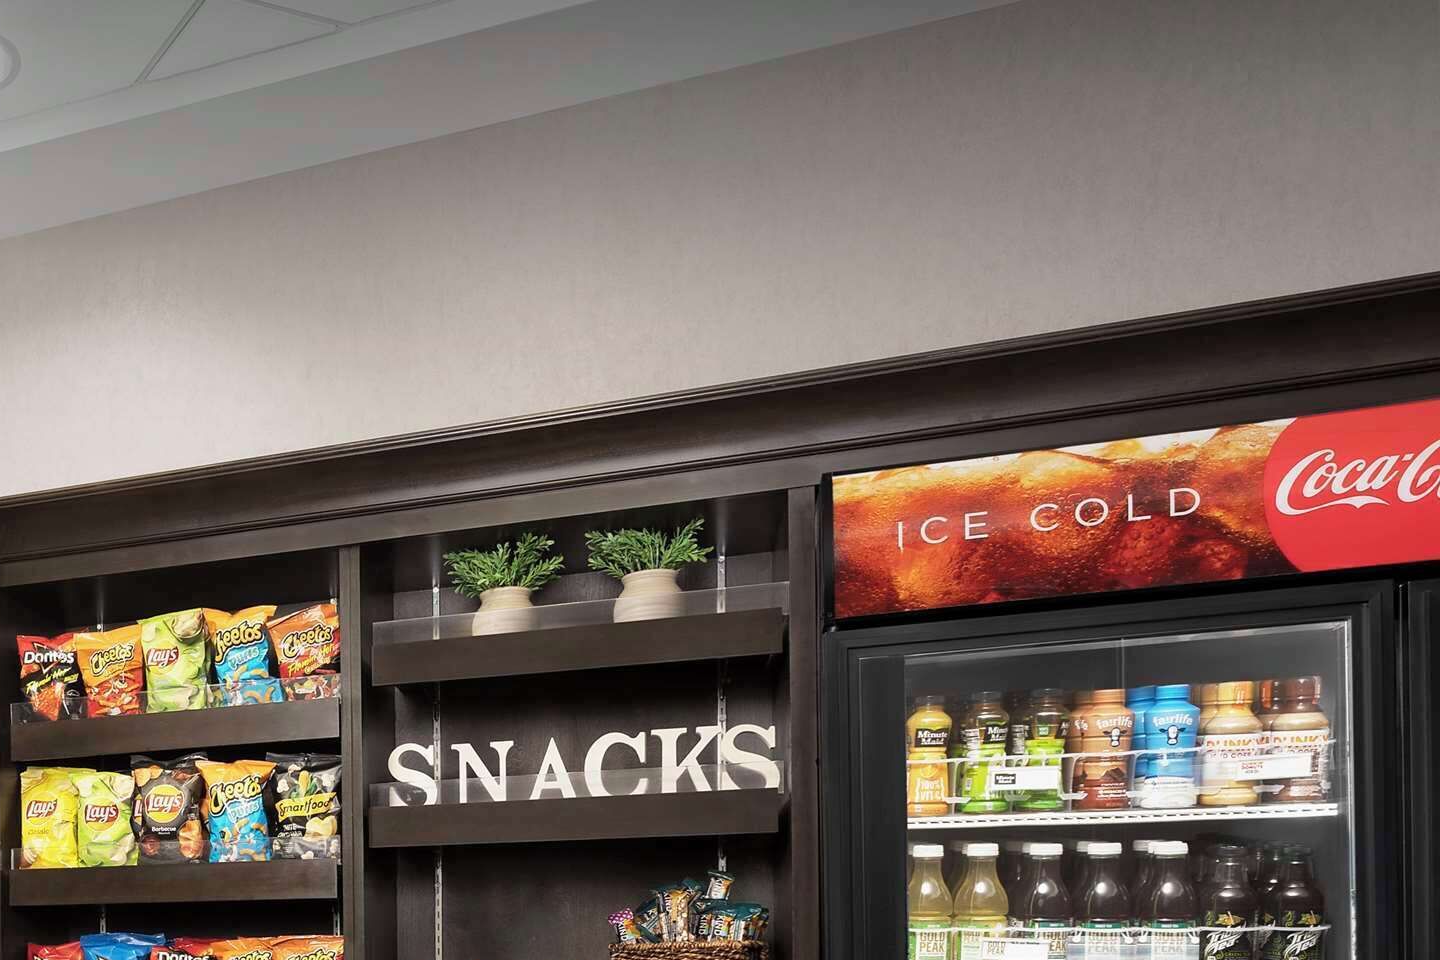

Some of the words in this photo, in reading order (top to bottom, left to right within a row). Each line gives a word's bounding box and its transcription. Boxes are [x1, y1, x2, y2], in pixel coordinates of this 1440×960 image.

[1274, 440, 1440, 516] Coca-C
[897, 511, 988, 551] ICE
[1029, 487, 1202, 533] COLD
[215, 621, 264, 662] heetos
[282, 623, 333, 659] Cheetos
[23, 650, 74, 664] Doritos
[90, 642, 135, 676] Cheetos
[146, 647, 180, 668] Lay's
[1096, 716, 1133, 730] fairlife
[1152, 713, 1193, 726] fairlife
[917, 730, 948, 738] Minute
[921, 737, 945, 745] Maid
[387, 723, 780, 806] SNACKS
[27, 798, 58, 819] Lay's
[85, 804, 120, 824] Lay's
[146, 792, 184, 816] Lay's
[279, 796, 331, 818] Smartfood
[664, 892, 672, 912] KIND
[618, 921, 628, 941] KIND
[698, 915, 707, 935] KIND
[714, 915, 723, 935] KIND
[919, 942, 945, 953] PEAK
[1049, 942, 1067, 952] EAK
